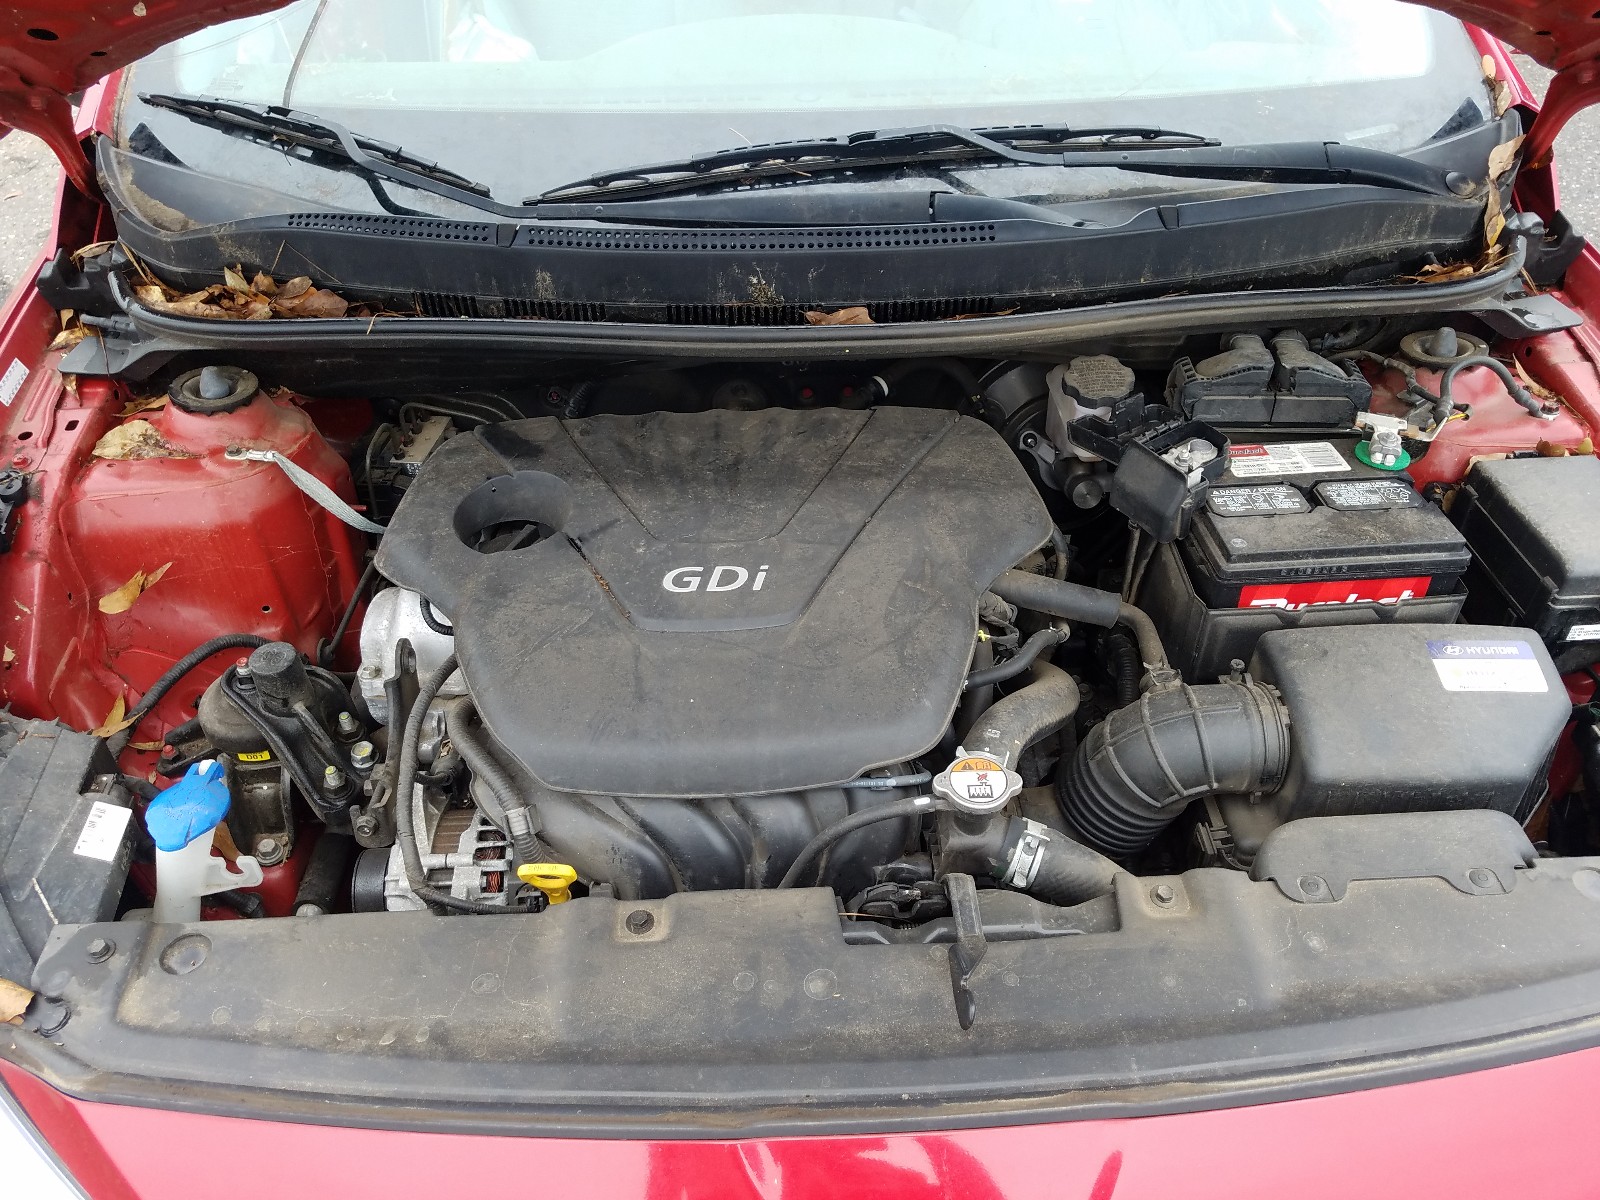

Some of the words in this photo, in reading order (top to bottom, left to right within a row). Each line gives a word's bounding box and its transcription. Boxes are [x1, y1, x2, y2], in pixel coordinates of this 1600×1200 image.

[1258, 486, 1287, 494] POISON
[662, 564, 769, 593] GDi
[1465, 646, 1520, 655] HYUNDAI
